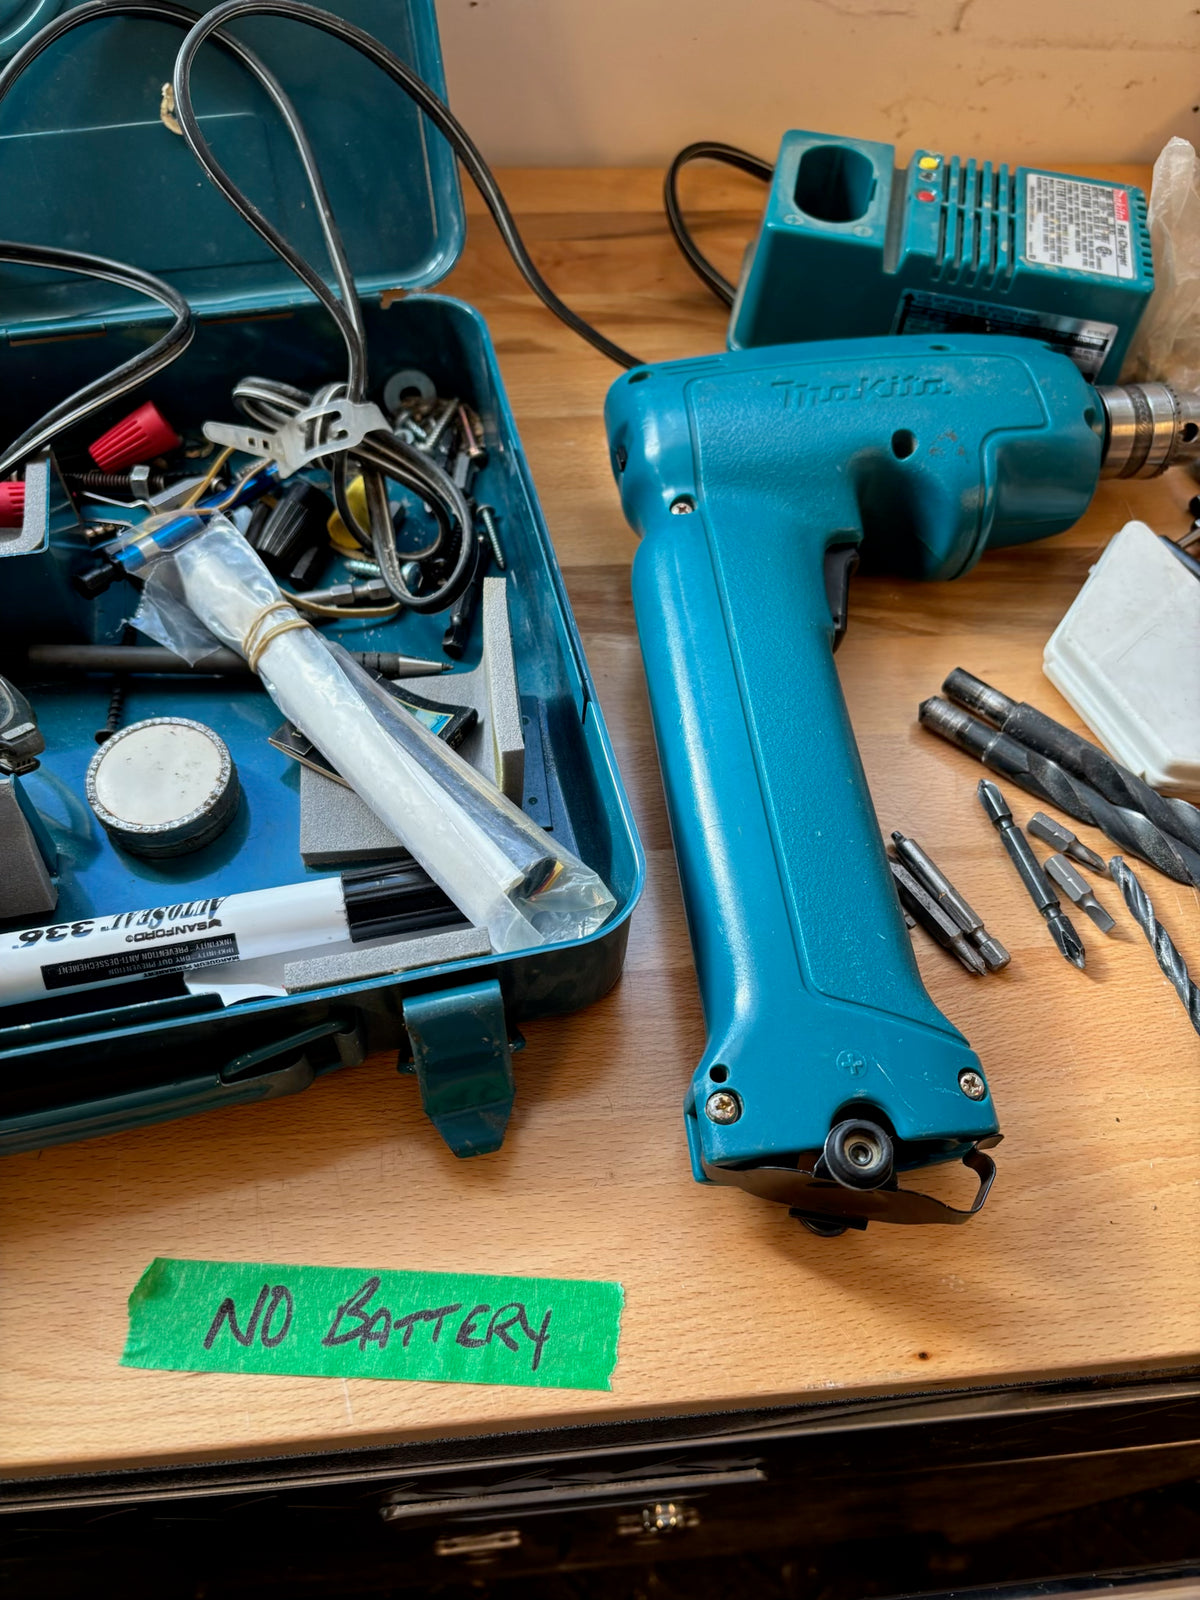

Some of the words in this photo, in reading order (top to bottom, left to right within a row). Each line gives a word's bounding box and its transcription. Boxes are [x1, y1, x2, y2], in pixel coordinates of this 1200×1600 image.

[1118, 224, 1128, 239] Fast
[1117, 240, 1128, 266] Charger
[204, 1283, 293, 1350] NO
[322, 1276, 552, 1371] BATTERY
